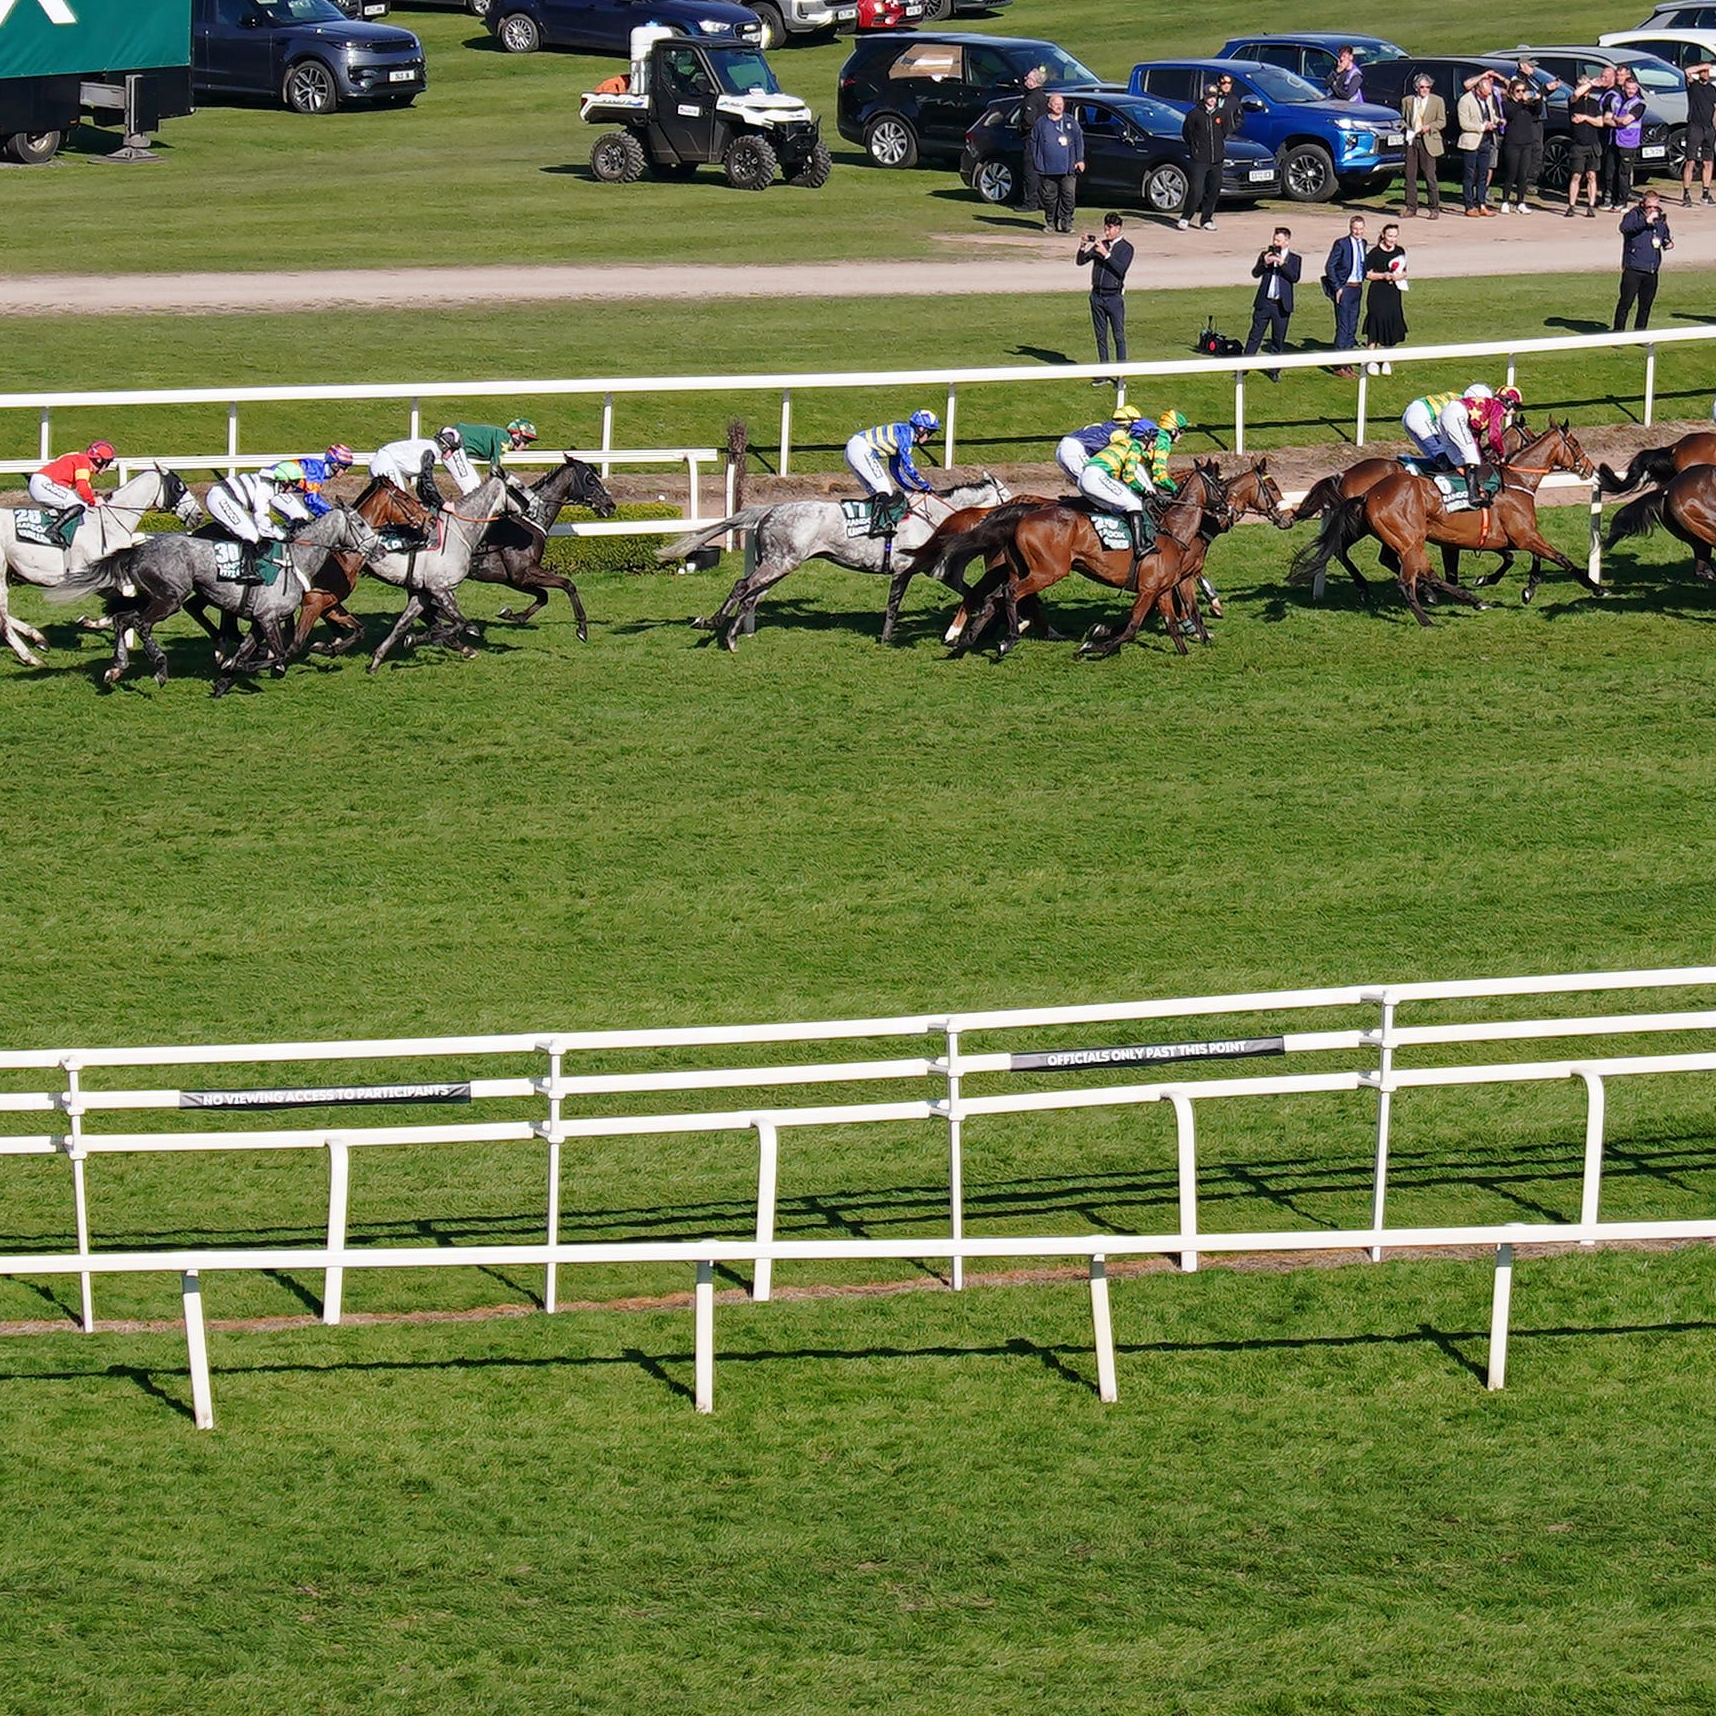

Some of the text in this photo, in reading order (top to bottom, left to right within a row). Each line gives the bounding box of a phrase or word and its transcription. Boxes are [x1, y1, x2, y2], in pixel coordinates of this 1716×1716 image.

[15, 509, 42, 524] 28
[842, 502, 866, 518] 17
[215, 542, 241, 563] 30
[1047, 1039, 1248, 1067] OFFICIALS ONLY PAST THIS POINT
[203, 1084, 451, 1106] NO VIEWING ACCESS TO PARTICIPANTS
